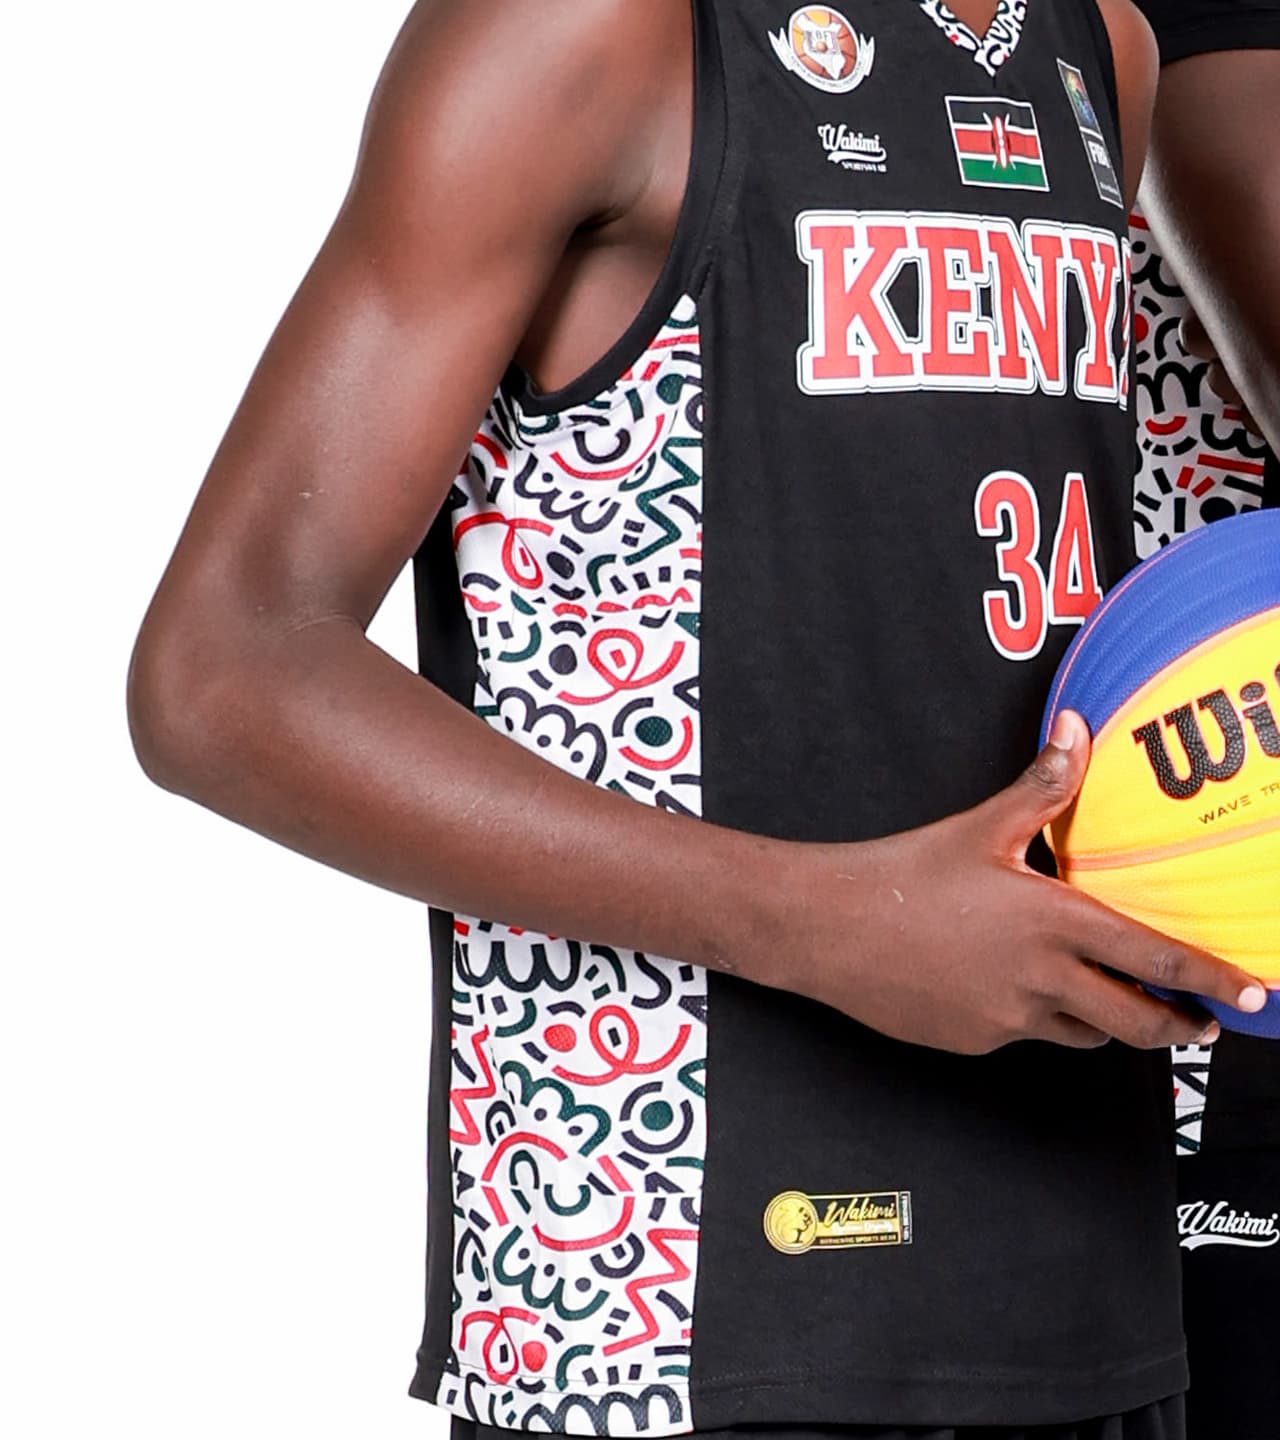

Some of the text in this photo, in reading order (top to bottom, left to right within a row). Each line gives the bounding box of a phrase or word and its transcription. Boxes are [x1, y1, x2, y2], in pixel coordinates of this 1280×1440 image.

[817, 123, 887, 164] Wakimi
[795, 210, 1131, 410] KENY
[975, 471, 1103, 661] 34
[1199, 794, 1253, 825] WAVE
[823, 1197, 895, 1228] Wakimi
[1176, 1200, 1280, 1251] Wakimi
